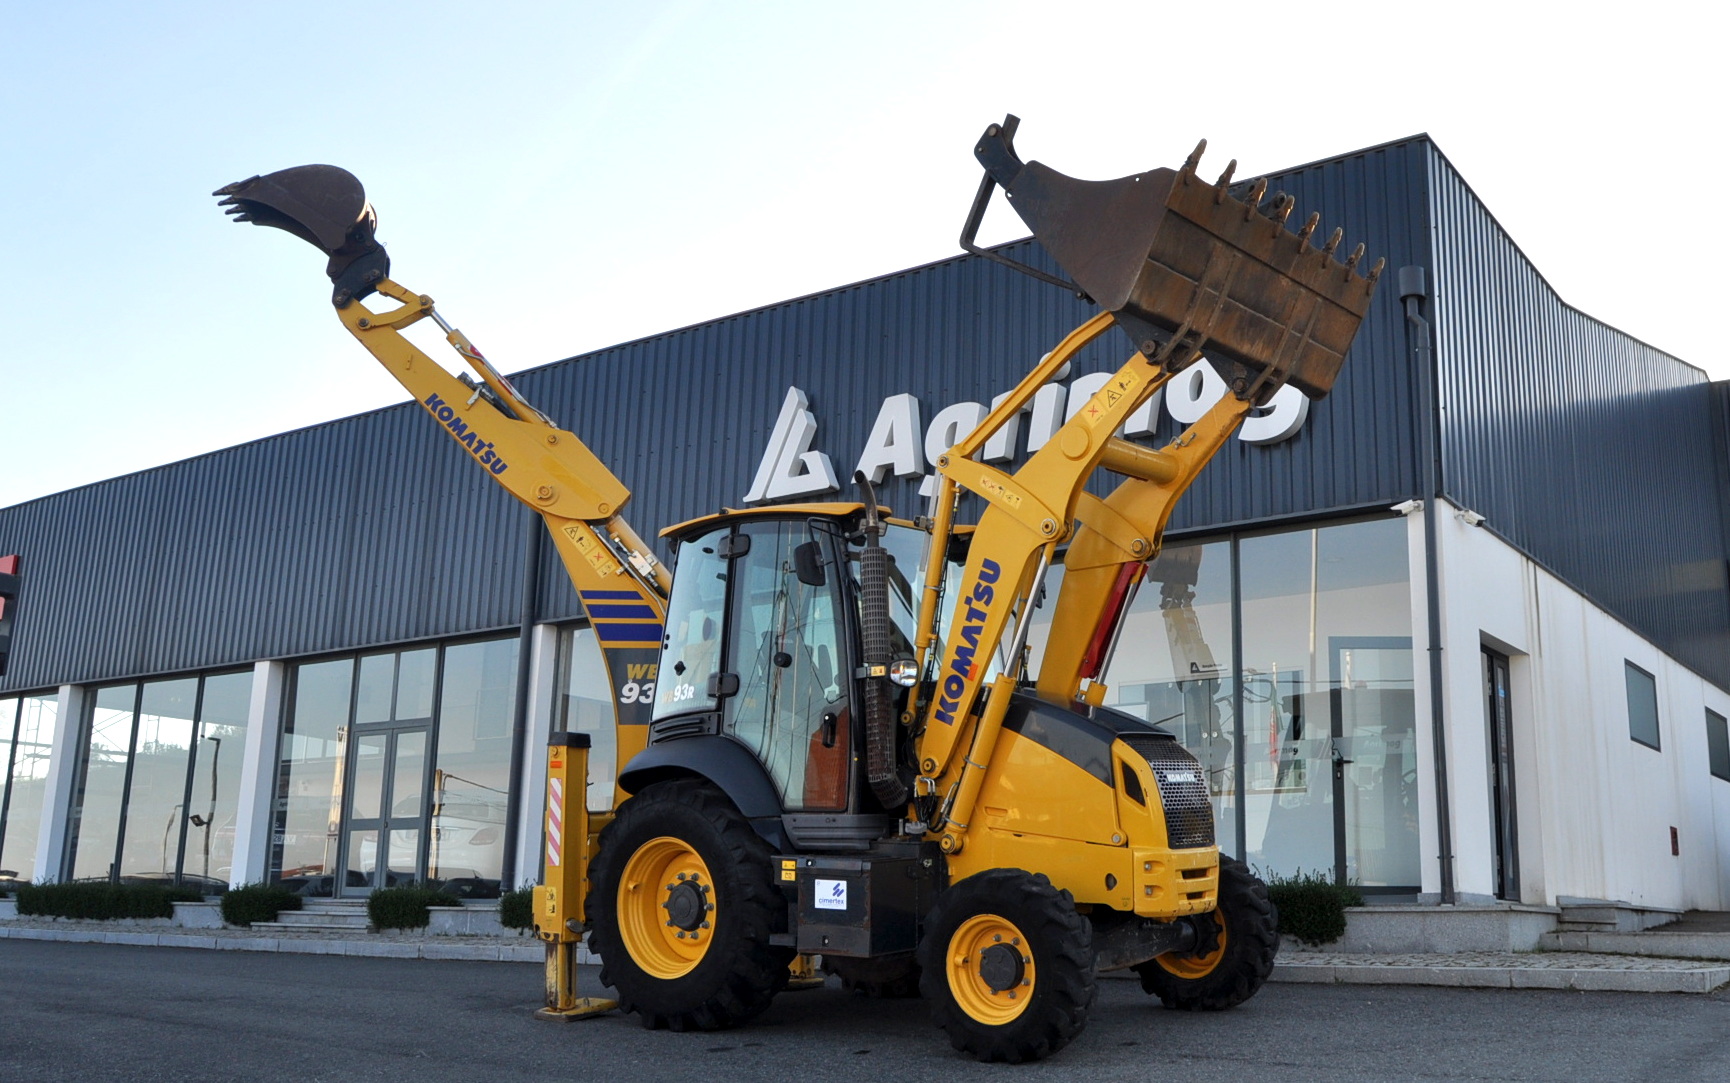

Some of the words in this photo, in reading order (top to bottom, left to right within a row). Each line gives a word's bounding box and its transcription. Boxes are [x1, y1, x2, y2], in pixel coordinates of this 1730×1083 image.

[424, 392, 509, 475] KOMATSU
[934, 557, 1001, 727] KOMATSU
[818, 897, 845, 905] cimertex
